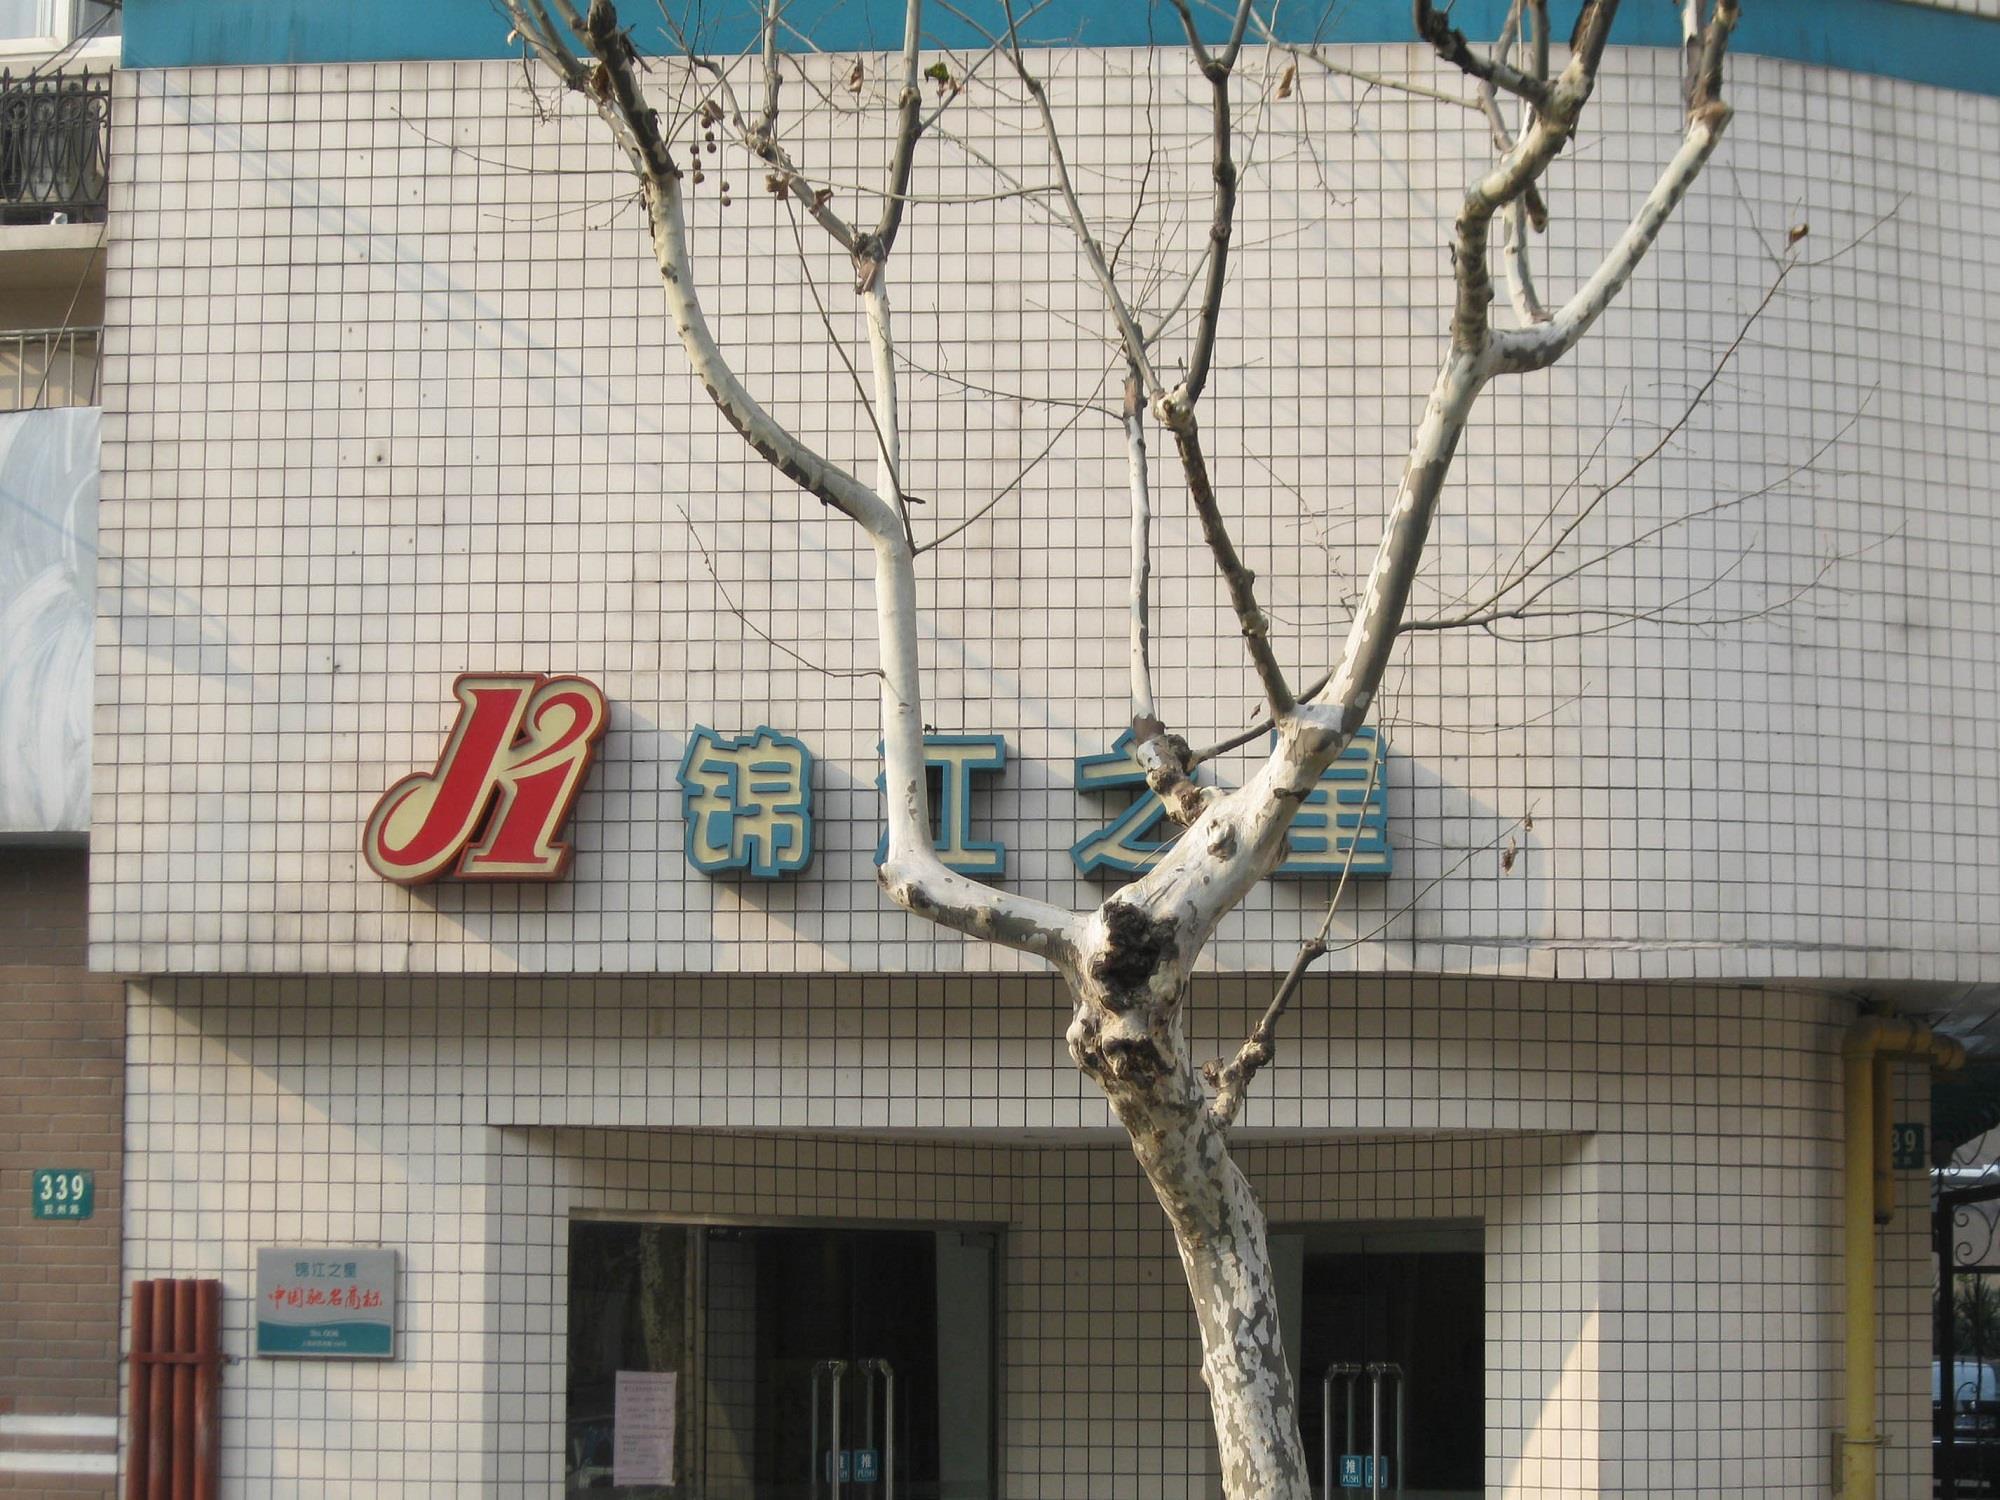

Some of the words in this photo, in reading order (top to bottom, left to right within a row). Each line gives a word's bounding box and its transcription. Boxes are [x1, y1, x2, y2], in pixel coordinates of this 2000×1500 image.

[40, 1174, 84, 1201] 339
[295, 1262, 357, 1278] 锦江之星
[267, 1284, 383, 1311] 中国驰名商标
